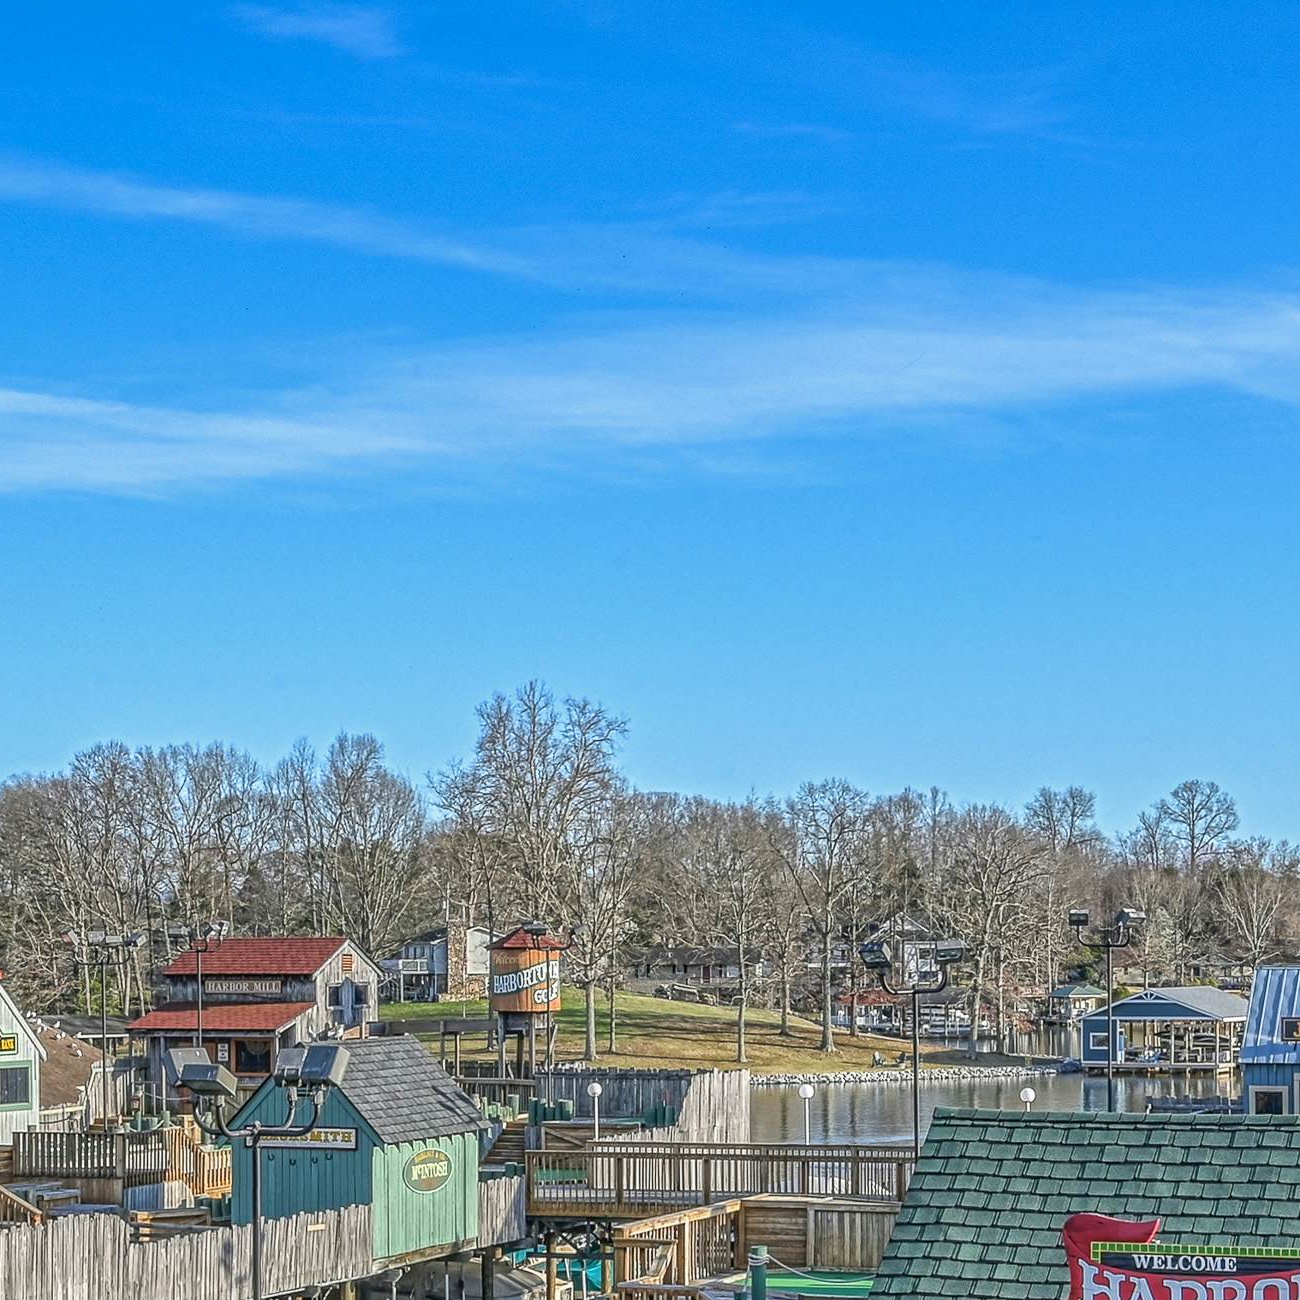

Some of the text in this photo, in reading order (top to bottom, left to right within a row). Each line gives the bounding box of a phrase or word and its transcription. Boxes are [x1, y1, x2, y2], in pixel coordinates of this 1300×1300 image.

[208, 981, 279, 992] HARBOR MILL
[1132, 1254, 1237, 1273] WELCOME
